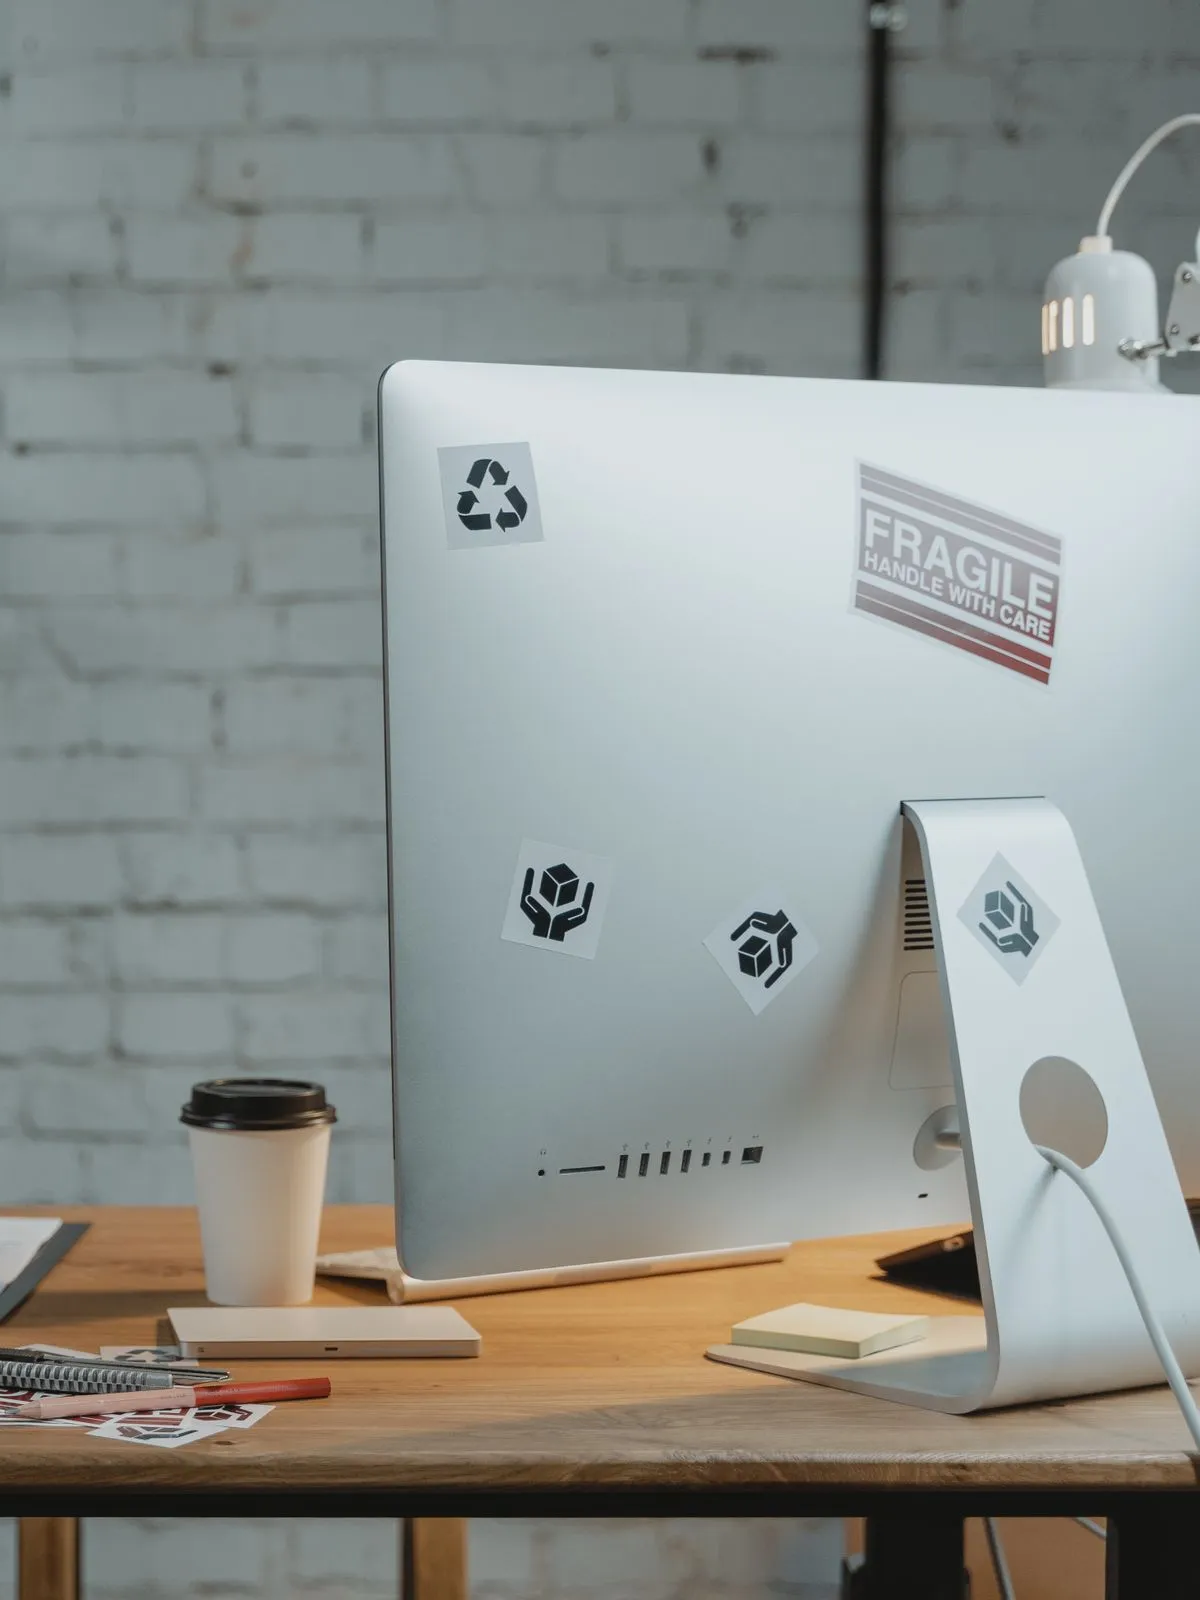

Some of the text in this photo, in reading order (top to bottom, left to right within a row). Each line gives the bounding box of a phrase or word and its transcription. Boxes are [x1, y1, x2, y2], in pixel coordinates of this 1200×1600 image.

[864, 550, 1050, 641] HANDLE WITH CARE
[865, 508, 1054, 620] FRAGILE
